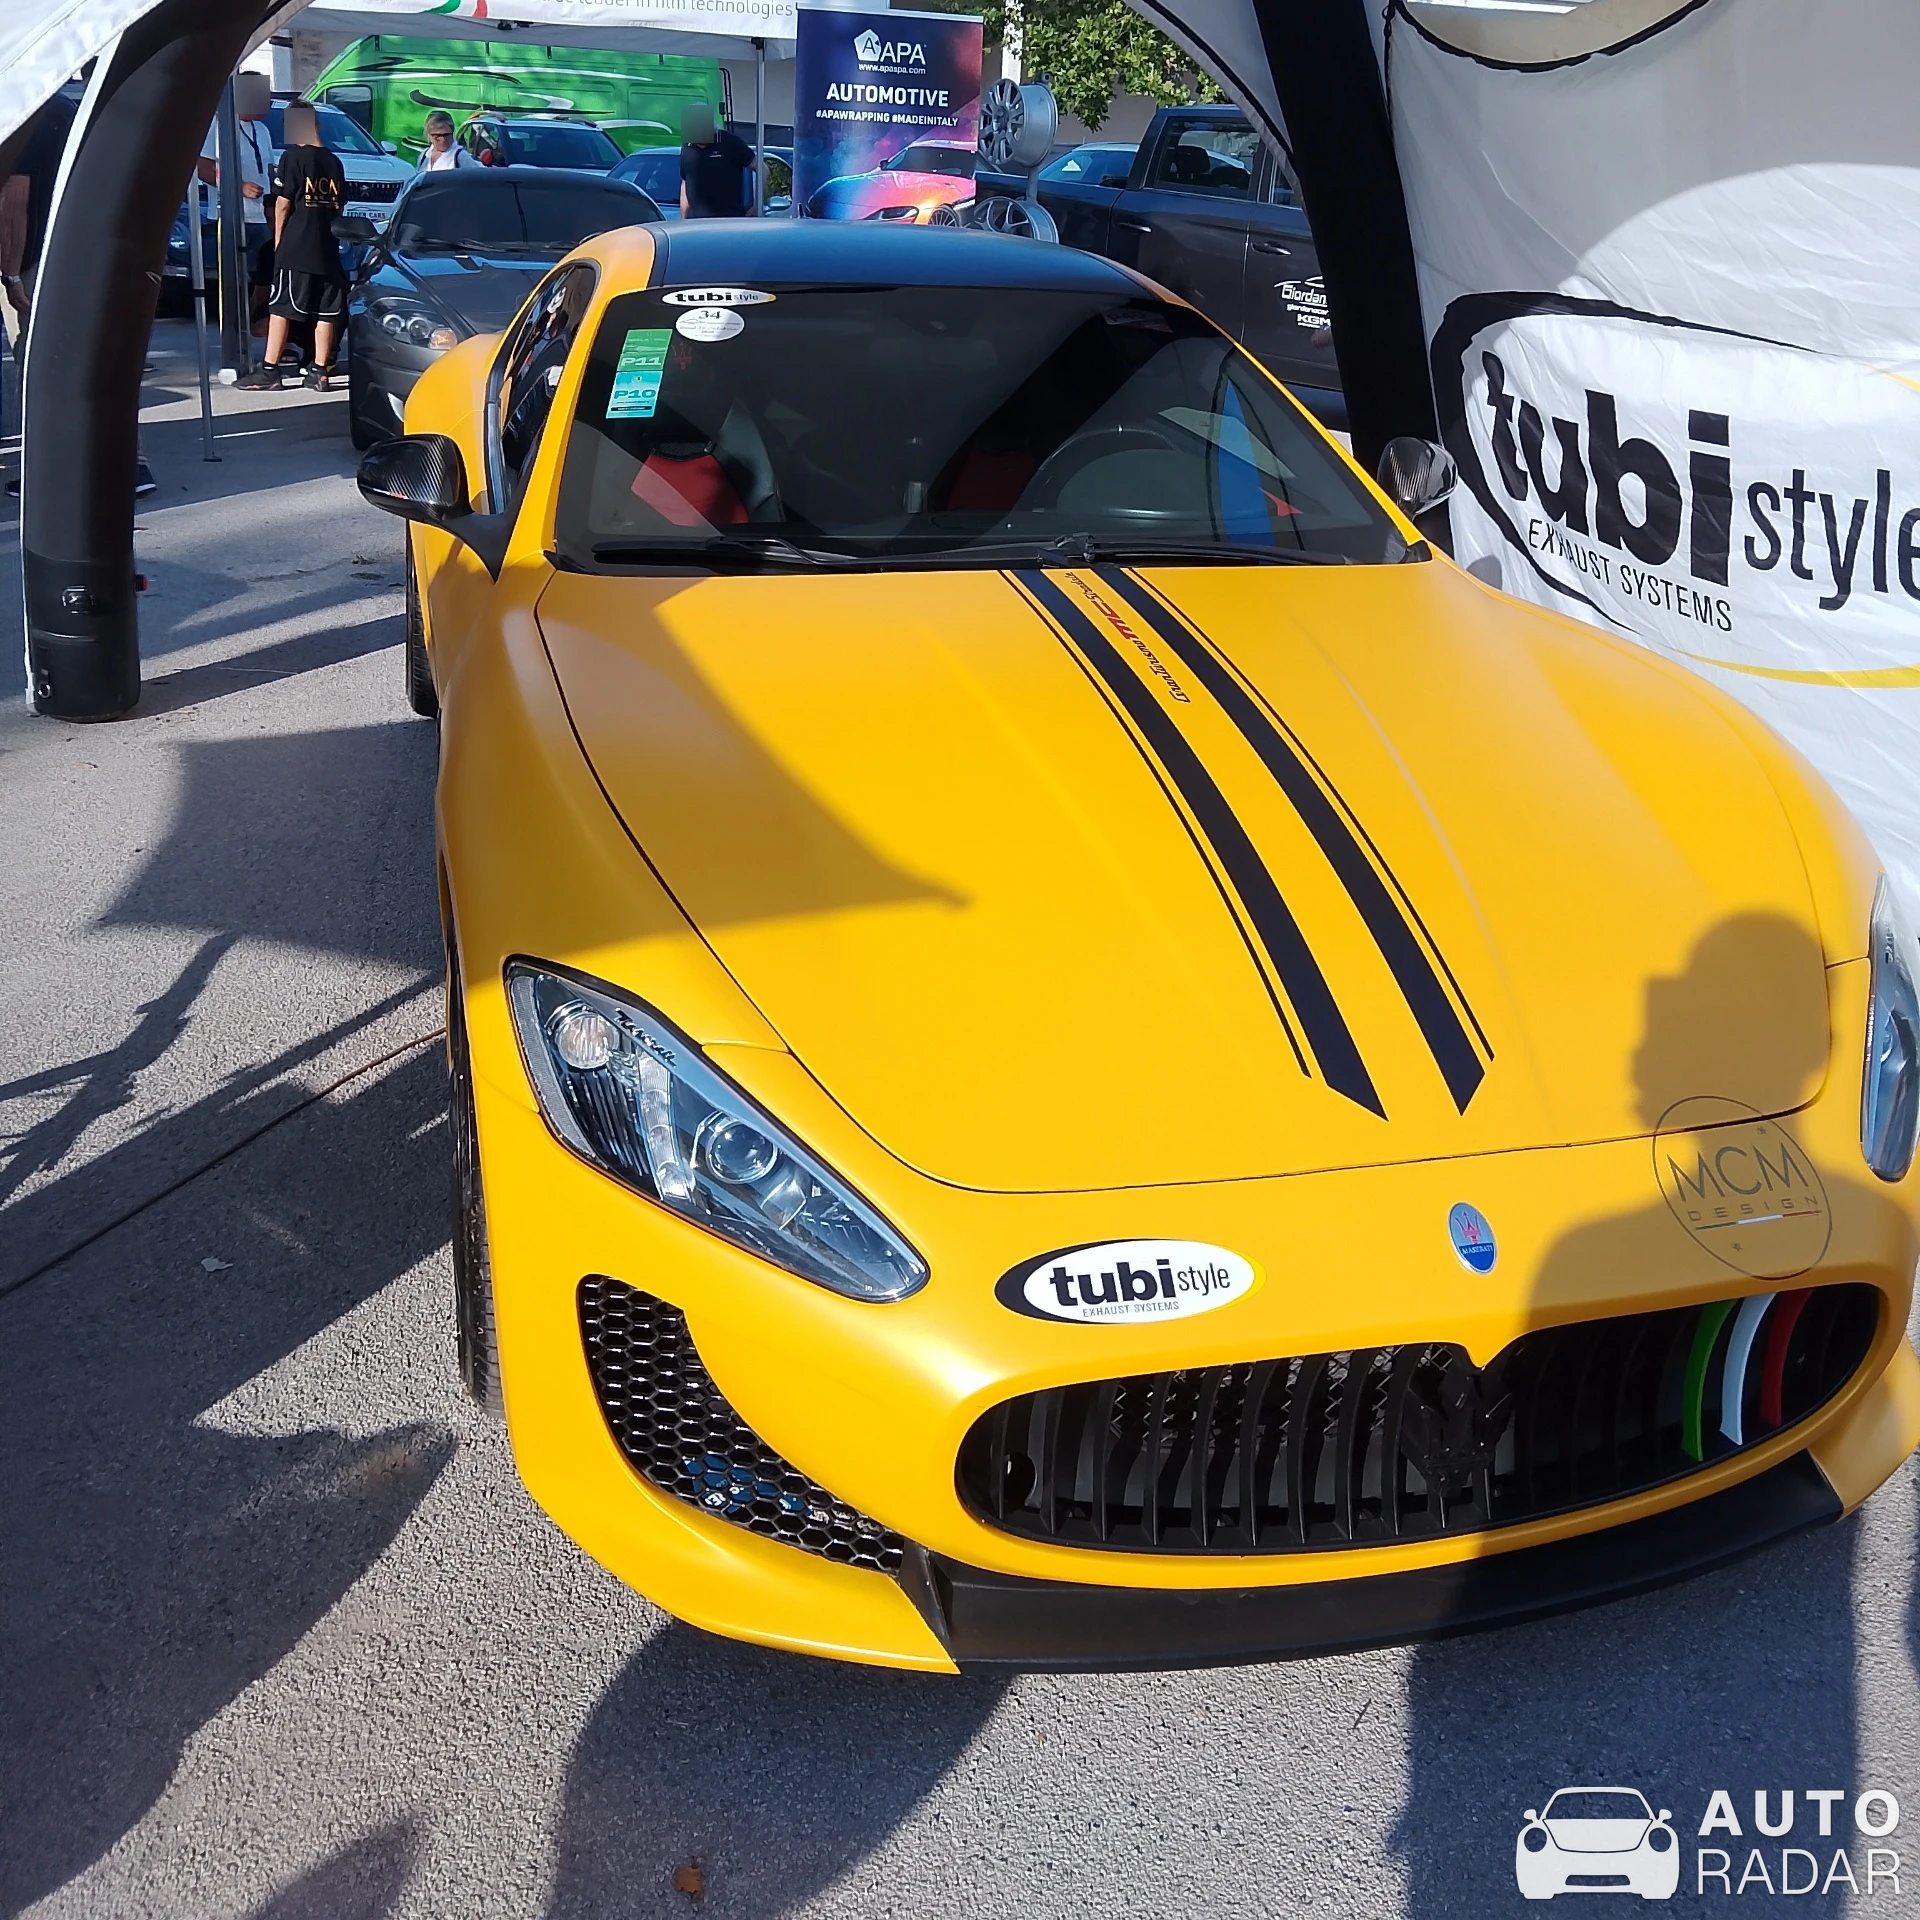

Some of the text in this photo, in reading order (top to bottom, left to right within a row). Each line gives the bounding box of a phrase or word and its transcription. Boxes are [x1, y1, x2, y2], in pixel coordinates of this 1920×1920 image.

[691, 0, 793, 19] technologies
[880, 42, 926, 65] APA
[858, 63, 926, 75] www.apaspa.com
[826, 83, 949, 107] AUTOMOTIVE
[816, 110, 959, 127] #APAWRAPPING #MADEINITALY
[675, 291, 759, 302] tubi style
[1281, 284, 1328, 305] Giordan
[699, 310, 722, 319] 34
[1297, 313, 1331, 327] KGM
[621, 357, 661, 367] P11
[614, 389, 656, 399] P10
[1482, 350, 1733, 587] tubi
[1528, 519, 1733, 632] EXHAUST SYSTEMS
[1666, 1139, 1809, 1202] MCM
[1687, 1195, 1818, 1222] DESIGN
[1049, 1258, 1231, 1307] tubi style
[1082, 1300, 1180, 1318] EXHAUST SYSTEMS
